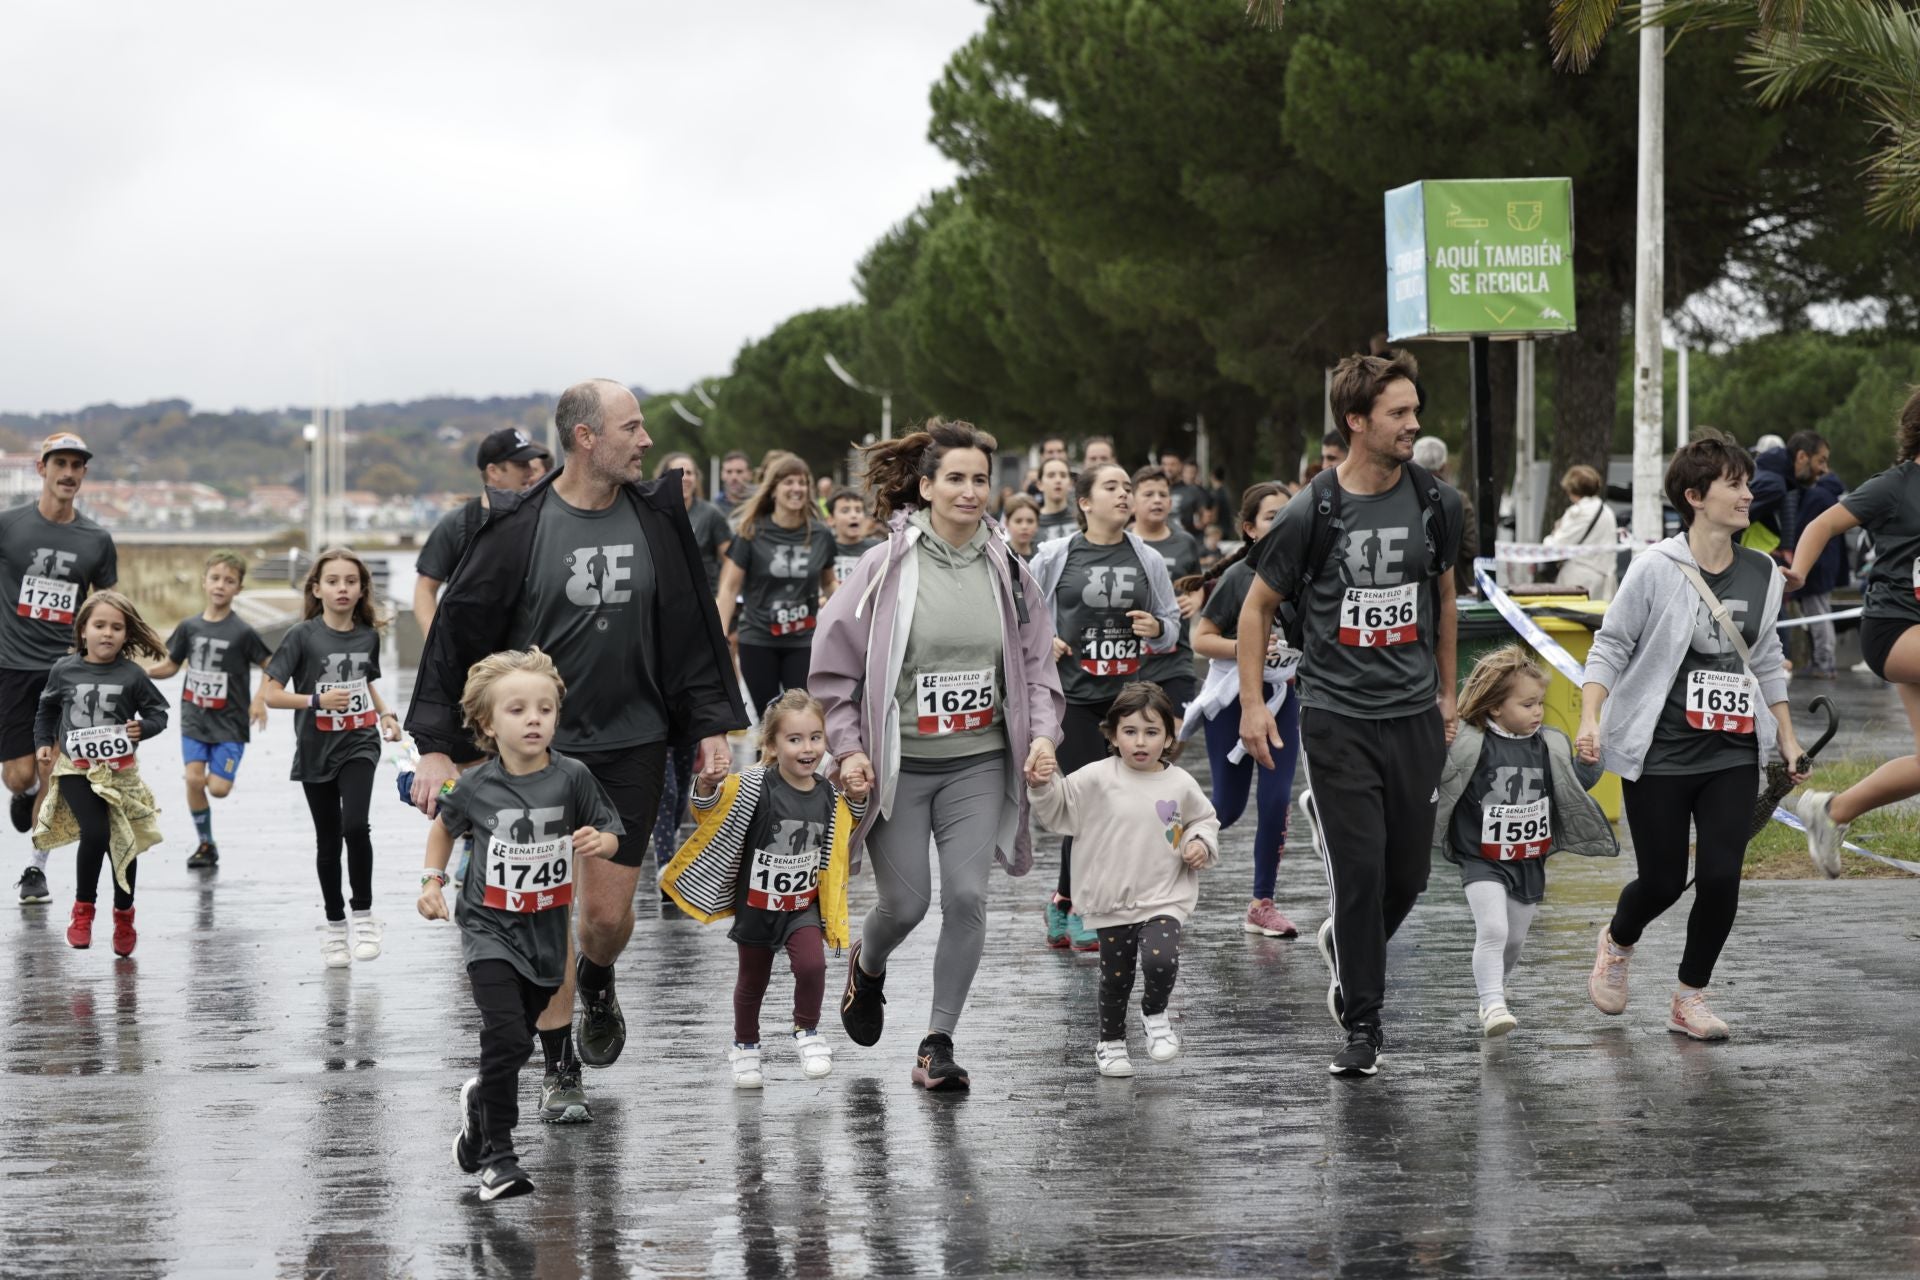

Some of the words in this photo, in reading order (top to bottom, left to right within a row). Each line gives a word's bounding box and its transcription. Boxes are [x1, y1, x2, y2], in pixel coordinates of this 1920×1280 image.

[1435, 240, 1480, 270] AQUÍ
[1484, 238, 1561, 267] TAMBIÉN
[1450, 273, 1470, 294] SE
[1475, 271, 1549, 293] RECICLA
[25, 589, 71, 609] 1738
[777, 604, 809, 624] 850
[1348, 602, 1413, 628] 1636
[1086, 640, 1137, 660] 1062
[924, 686, 992, 713] 1625
[1693, 688, 1749, 714] 1635
[72, 738, 128, 759] 1869
[1489, 816, 1548, 842] 1595
[537, 844, 555, 853] ELZO
[493, 858, 567, 889] 1749
[757, 866, 818, 893] 1626
